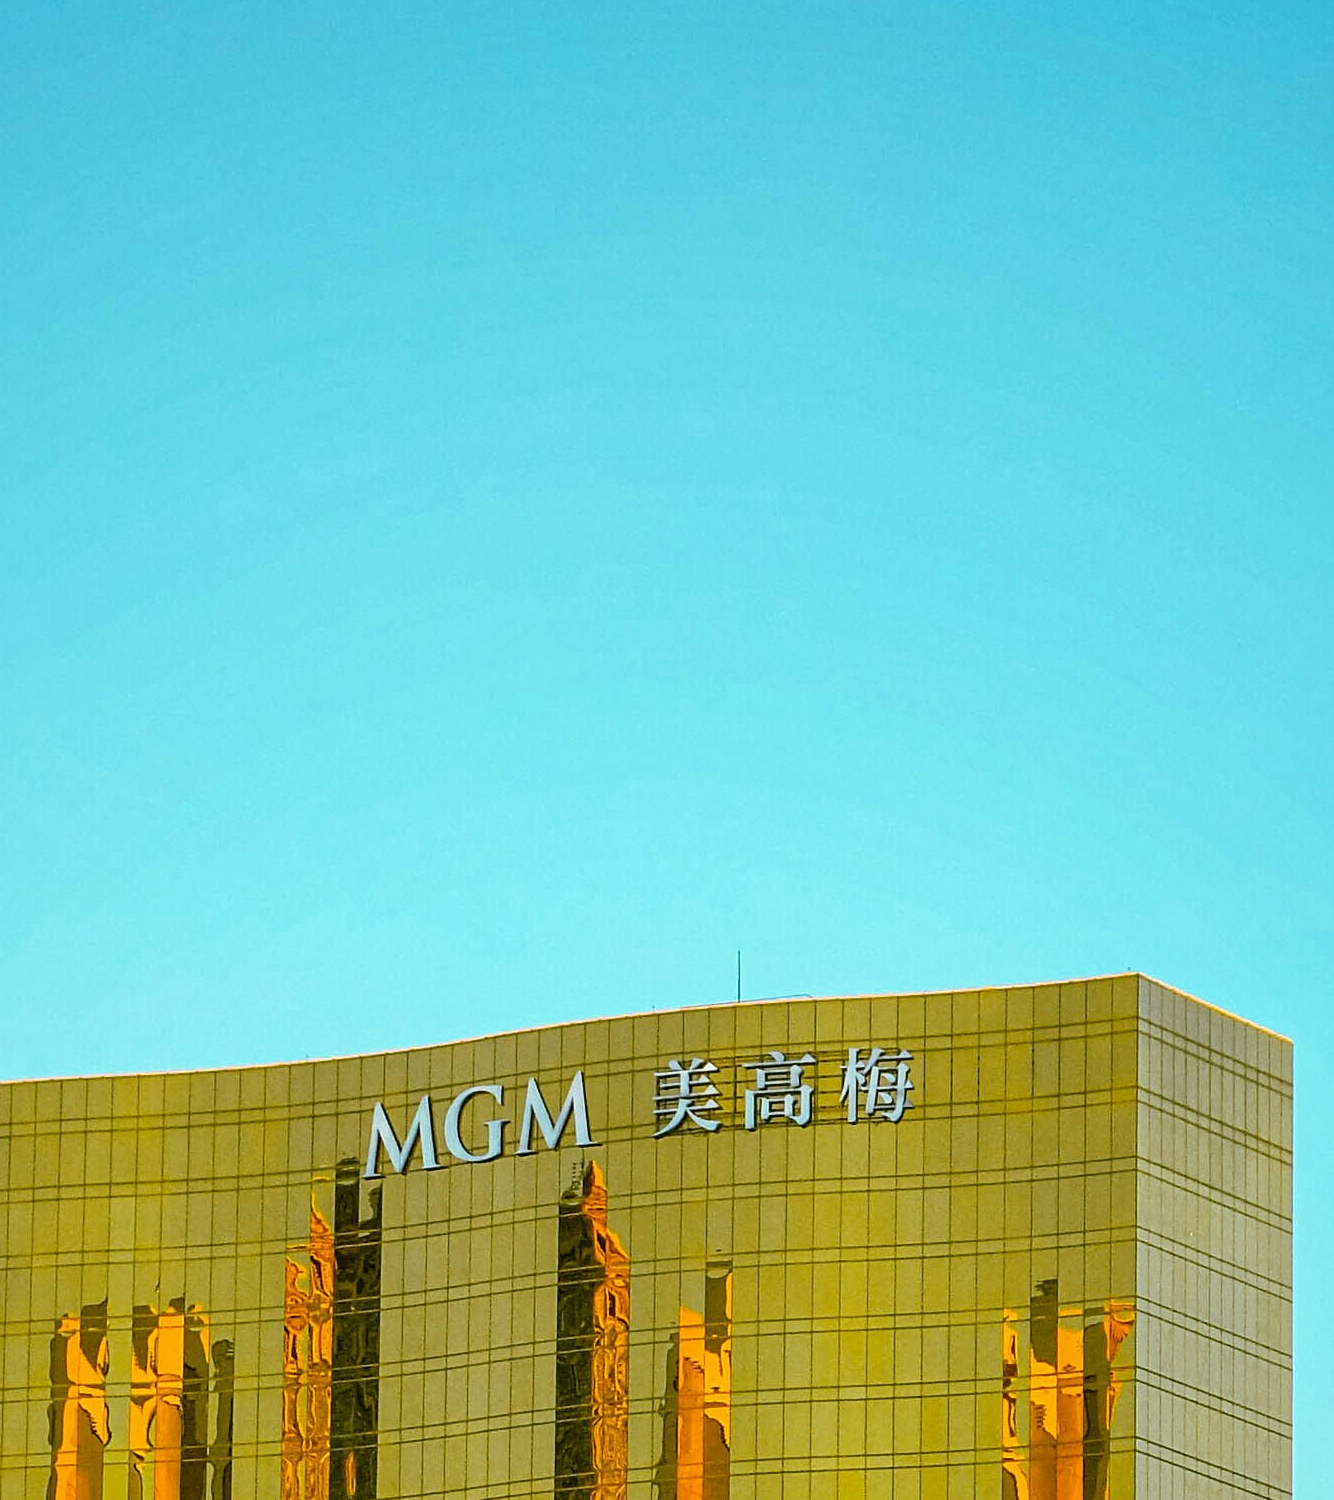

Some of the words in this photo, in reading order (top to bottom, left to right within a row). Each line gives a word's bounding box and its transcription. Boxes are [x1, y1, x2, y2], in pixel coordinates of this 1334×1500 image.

[363, 1070, 599, 1179] MGM
[651, 1047, 914, 1138] 美高梅
